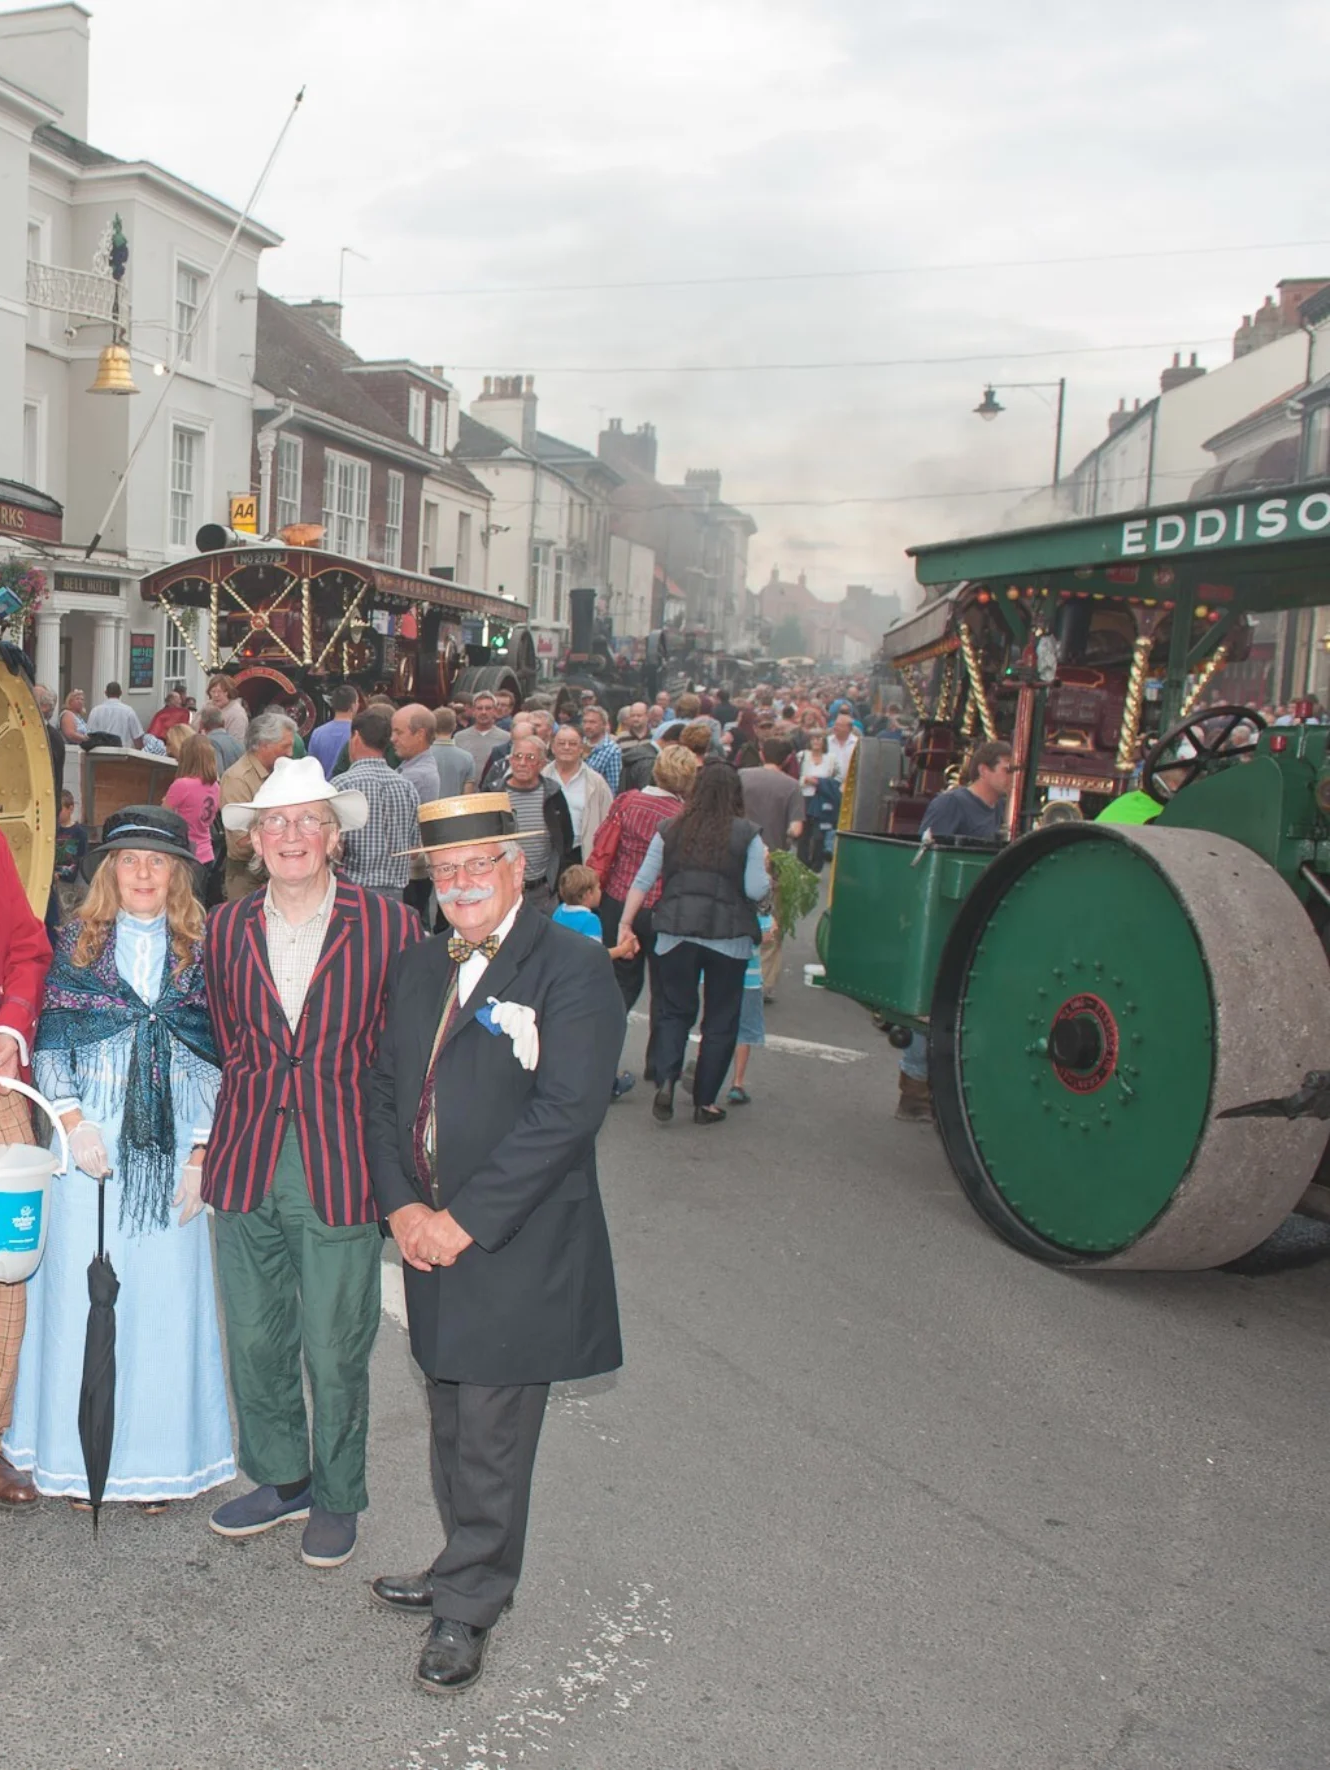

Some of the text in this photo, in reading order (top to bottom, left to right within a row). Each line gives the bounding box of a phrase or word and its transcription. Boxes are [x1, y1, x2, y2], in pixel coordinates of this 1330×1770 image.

[233, 502, 255, 519] AA
[1121, 491, 1330, 557] EDDISO
[61, 575, 114, 594] BELL HOTEL
[200, 795, 215, 822] 3
